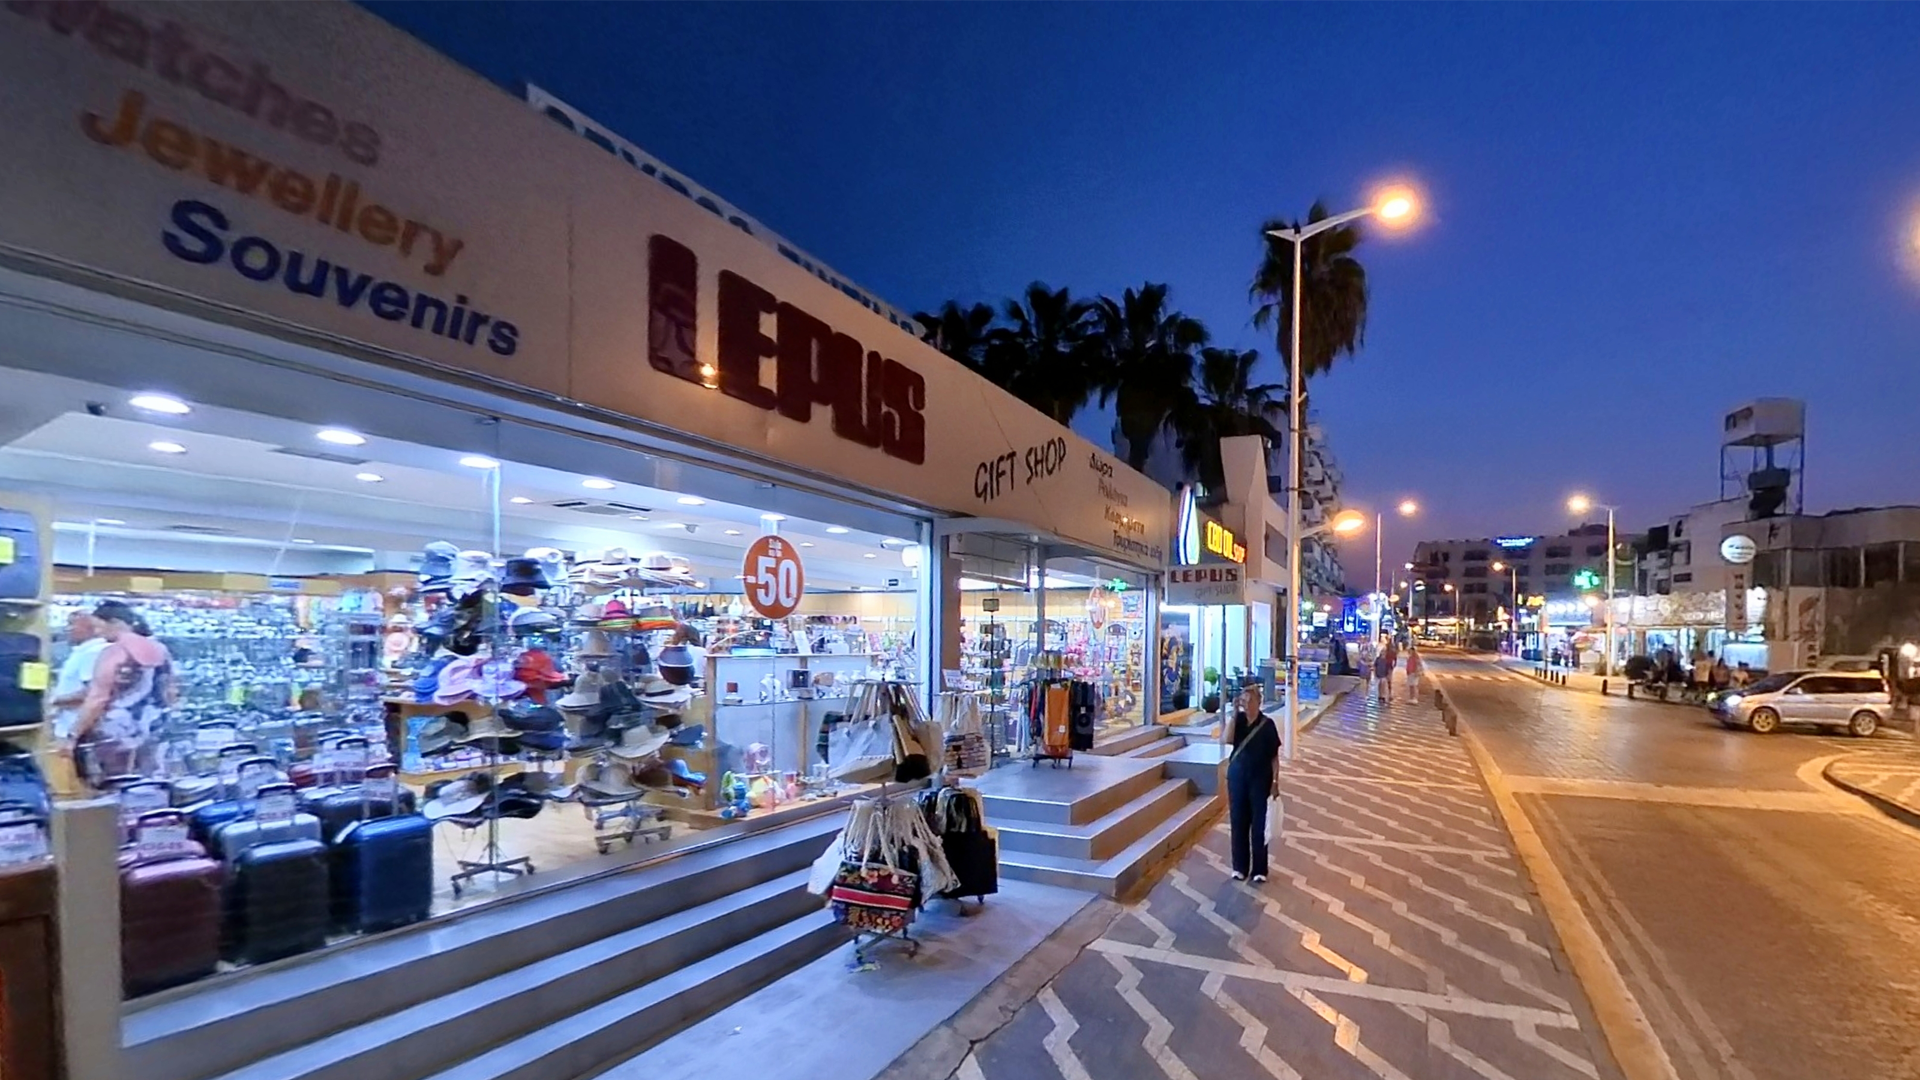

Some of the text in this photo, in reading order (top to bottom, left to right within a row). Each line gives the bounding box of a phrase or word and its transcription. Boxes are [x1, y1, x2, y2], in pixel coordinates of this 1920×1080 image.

[81, 89, 464, 276] Jewellery
[162, 200, 520, 357] Souvenirs
[648, 234, 925, 465] LEPUS
[974, 437, 1067, 504] GIFT SHOP
[746, 555, 798, 608] -50
[1170, 568, 1238, 584] LEPUS
